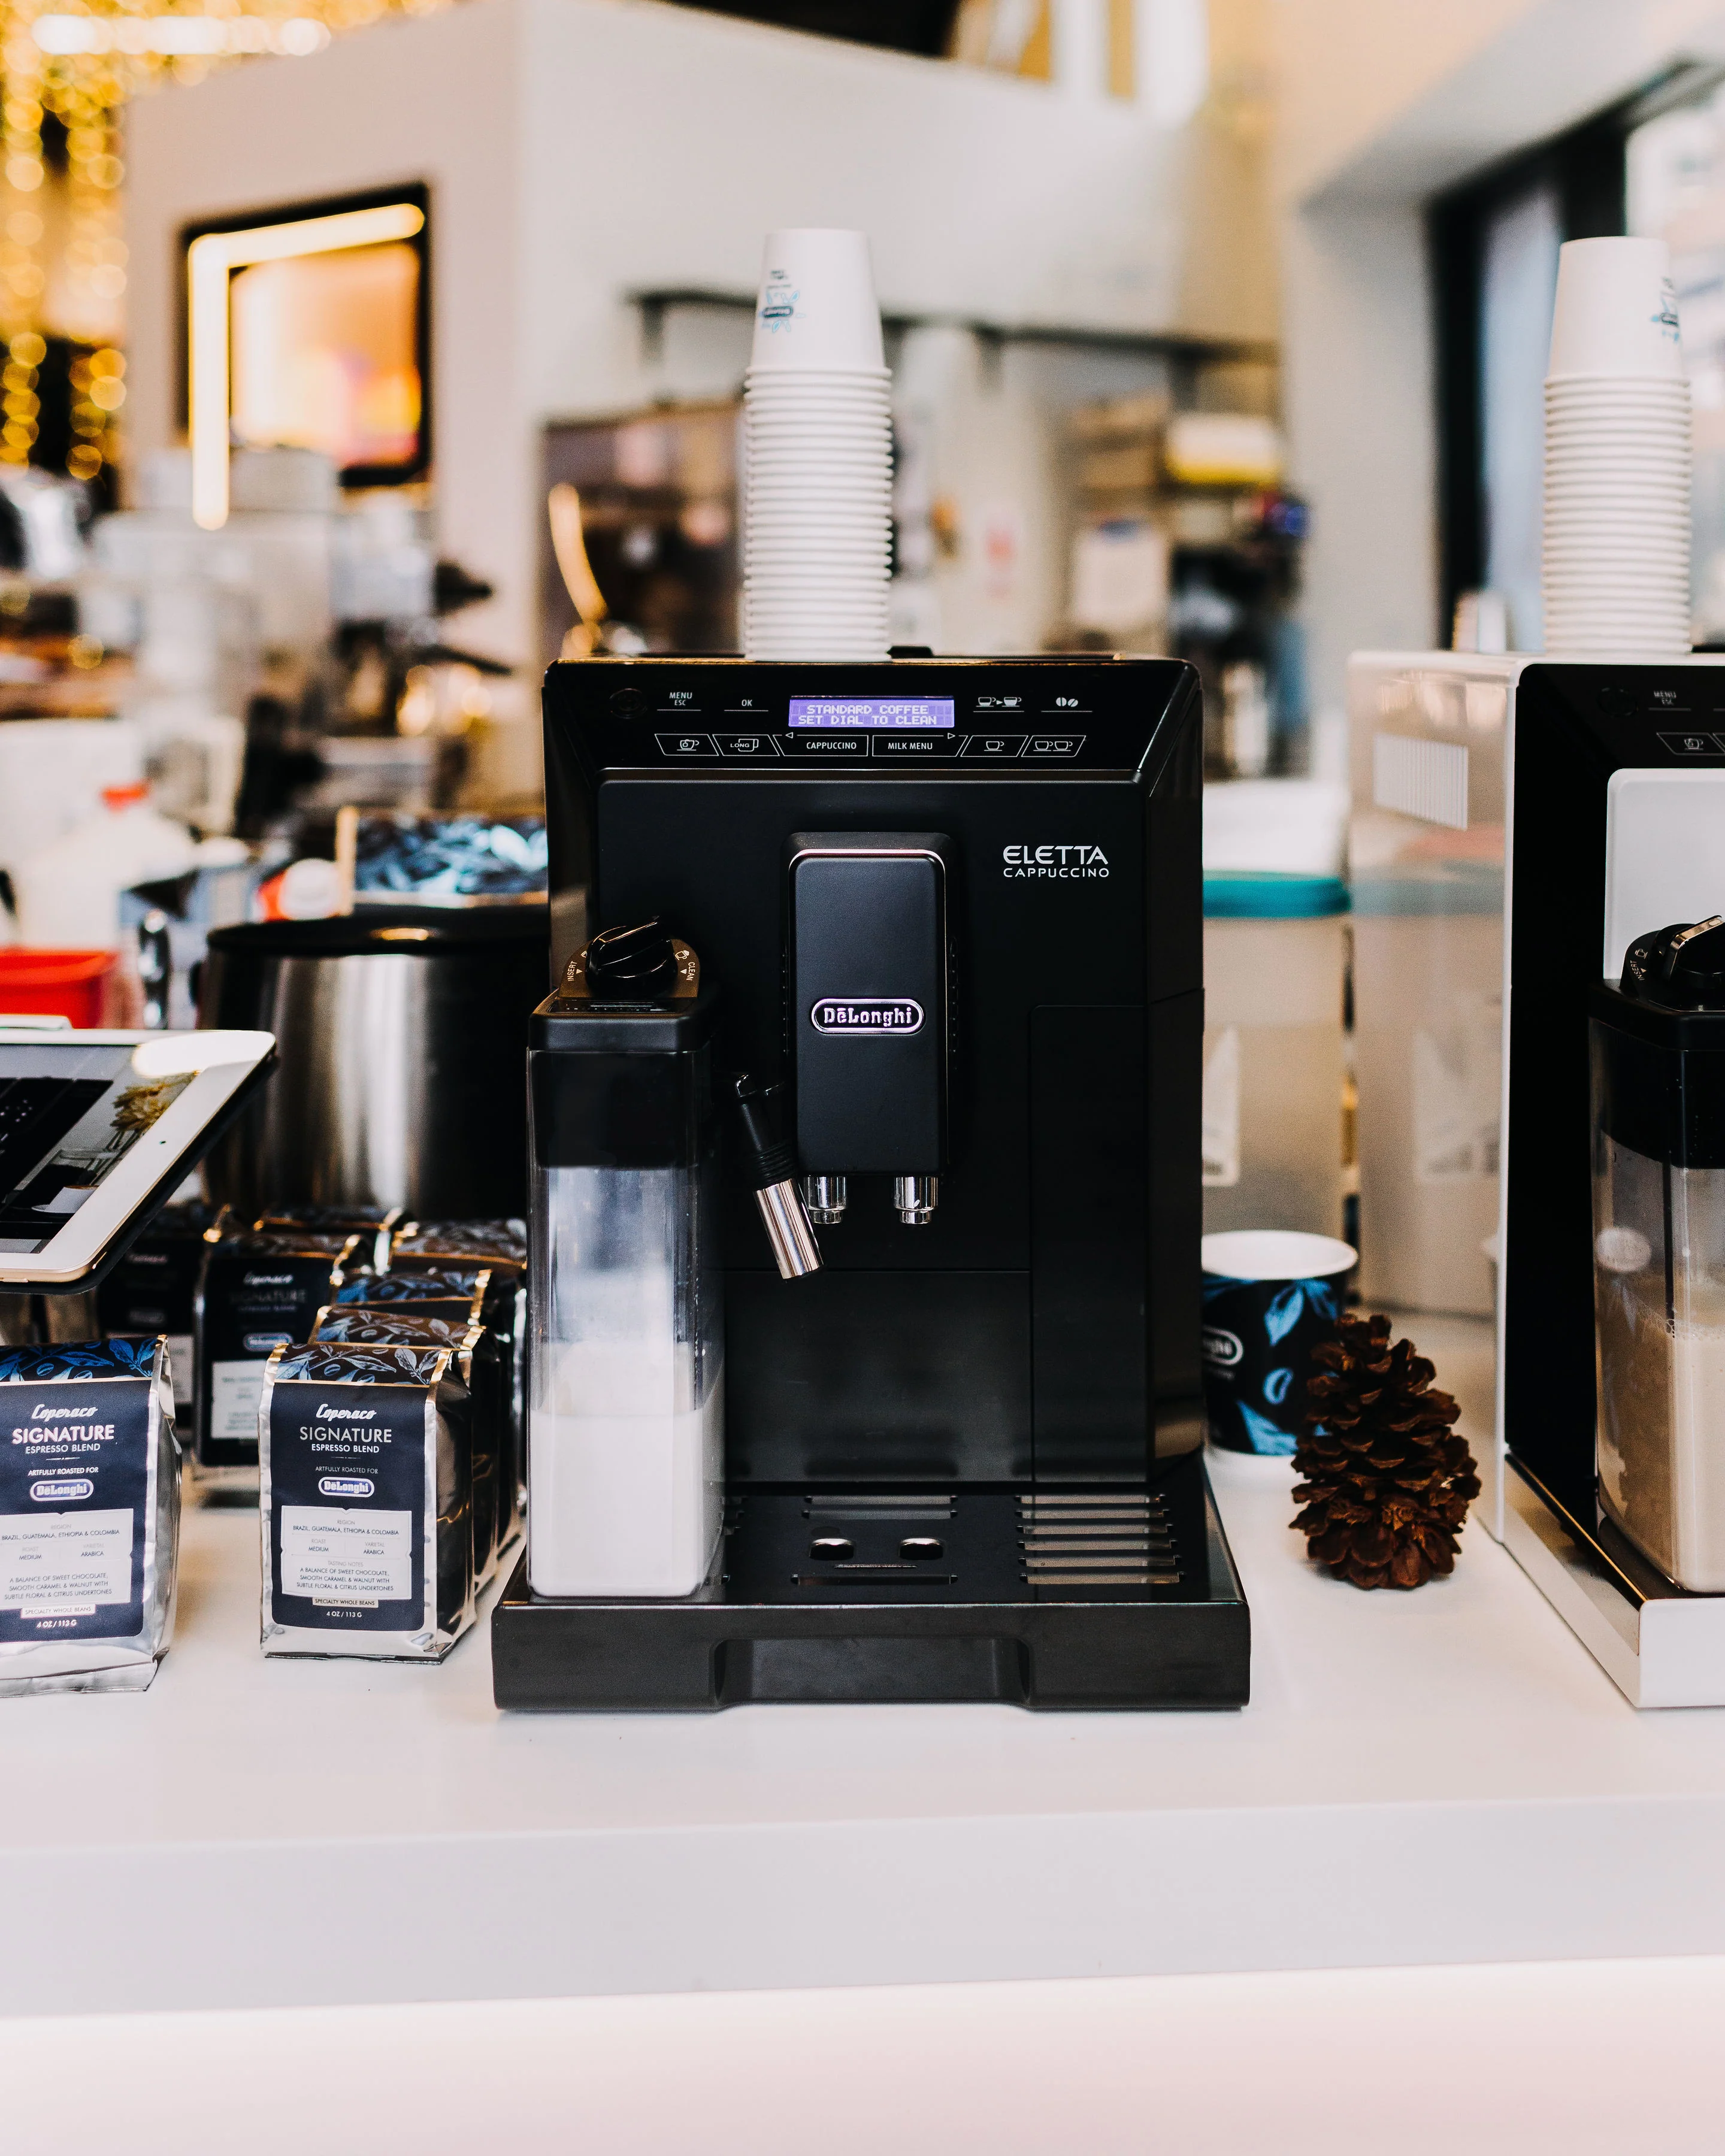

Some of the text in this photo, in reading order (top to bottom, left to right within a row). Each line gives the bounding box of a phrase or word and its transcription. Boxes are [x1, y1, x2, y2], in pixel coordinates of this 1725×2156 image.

[807, 705, 928, 714] STANDARD COFFEE
[798, 716, 937, 725] SET DIAL TO CLEAN
[1003, 846, 1108, 864] ELETTA
[1003, 868, 1109, 877] CAPPUCCINO
[567, 961, 577, 982] INSERT
[686, 962, 695, 981] CLEAN
[12, 1425, 114, 1444] SIGNATURE
[299, 1427, 392, 1443] SIGNATURE
[25, 1443, 100, 1454] ESPRESSO BLEND
[311, 1443, 350, 1452] ESPRESSO
